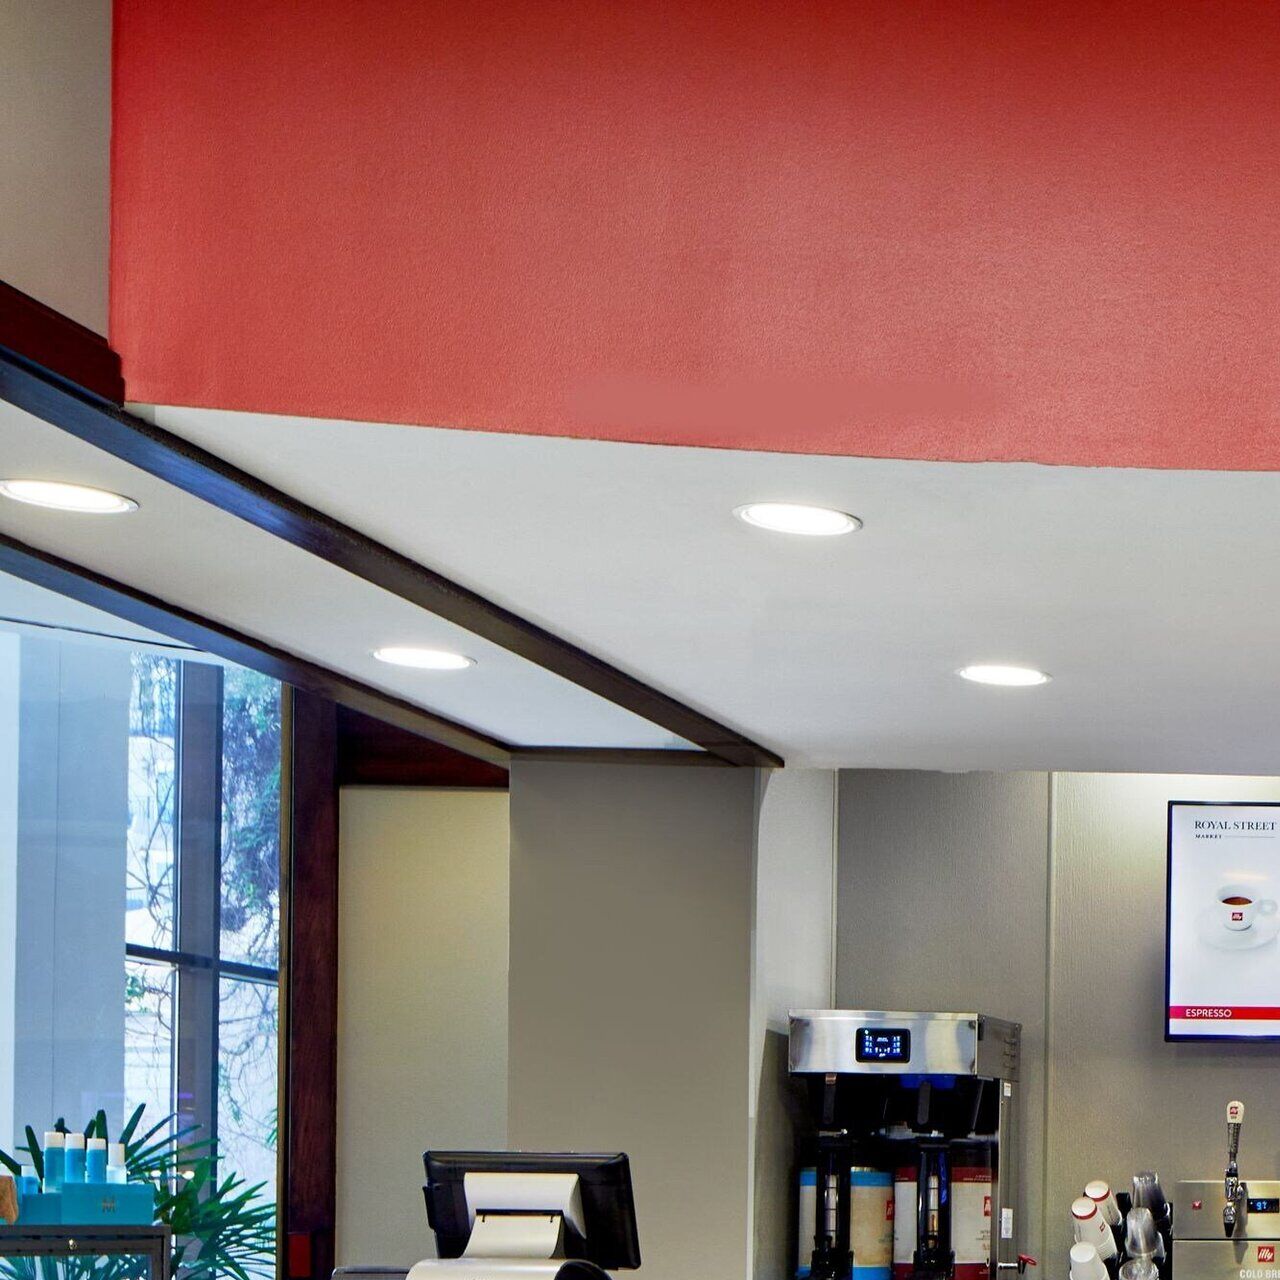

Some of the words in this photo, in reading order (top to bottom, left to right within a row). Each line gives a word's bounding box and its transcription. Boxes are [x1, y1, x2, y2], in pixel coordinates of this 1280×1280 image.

[1194, 820, 1231, 830] ROYAL
[1233, 821, 1277, 831] STREET
[1185, 1008, 1232, 1018] ESPRESSO
[1258, 1248, 1274, 1261] illy
[1239, 1269, 1263, 1279] COLD
